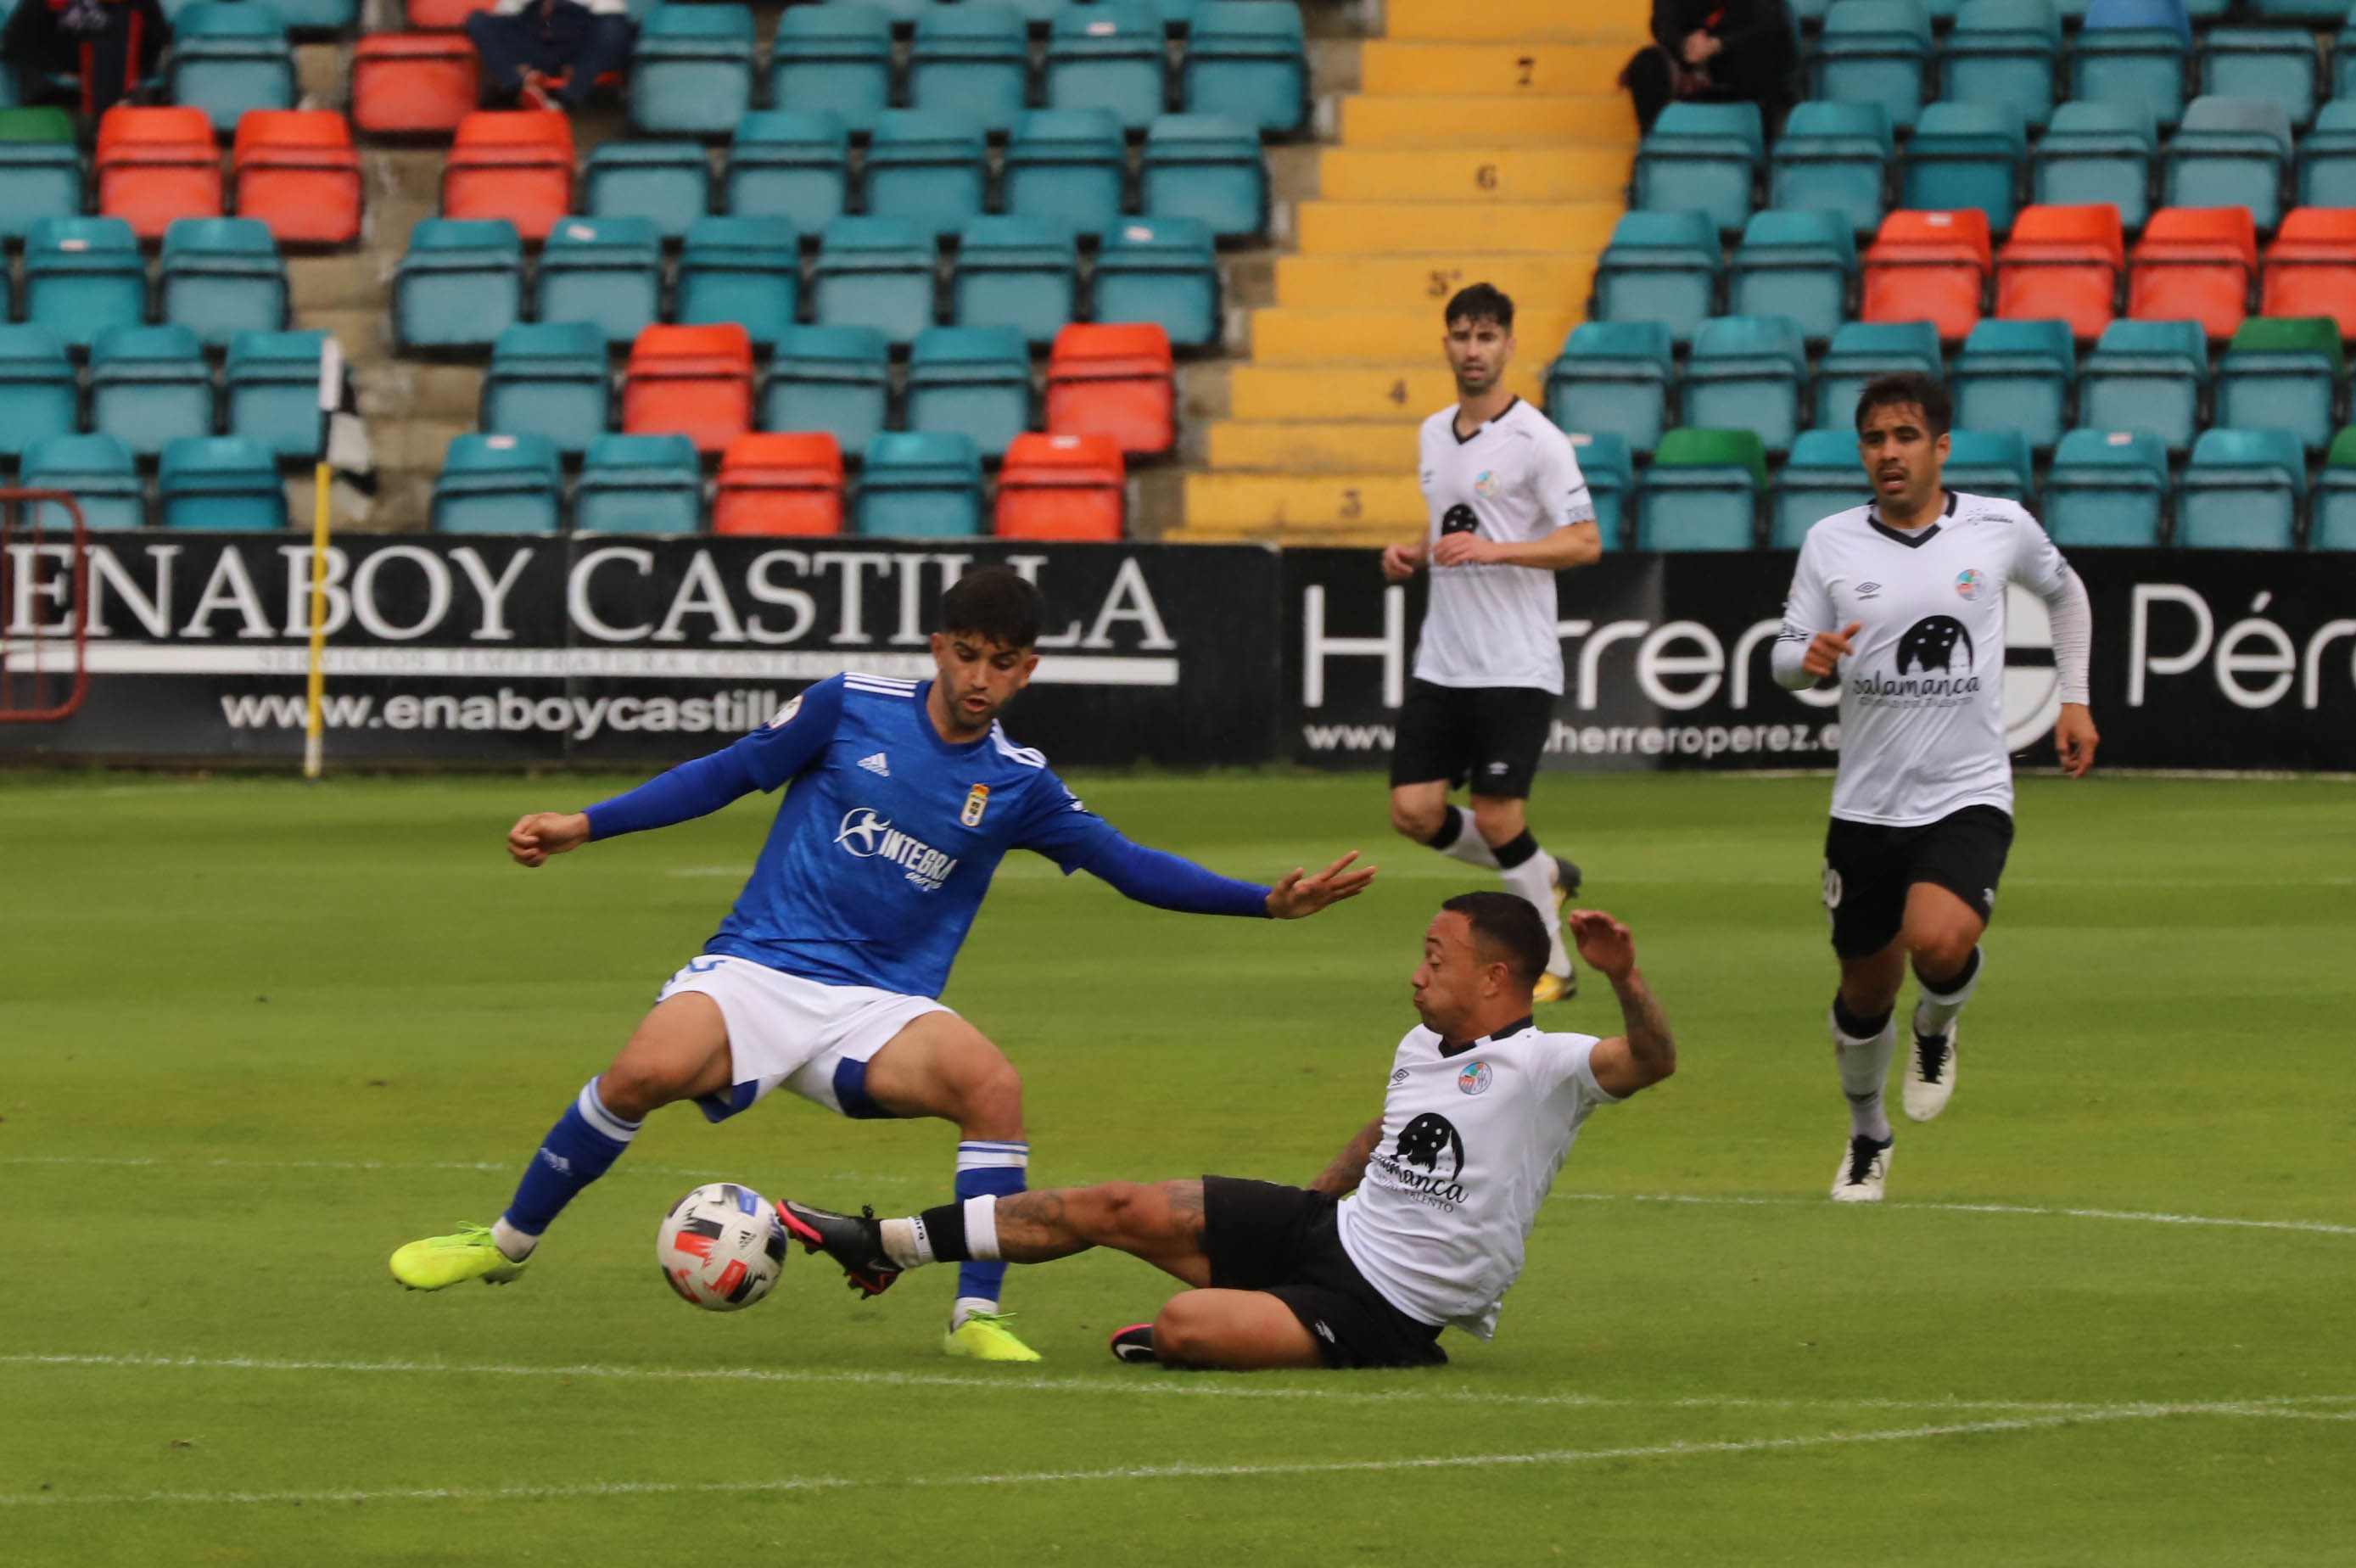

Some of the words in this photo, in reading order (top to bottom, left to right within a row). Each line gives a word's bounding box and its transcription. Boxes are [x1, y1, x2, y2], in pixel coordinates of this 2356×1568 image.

[1475, 164, 1497, 190] 6
[1387, 378, 1408, 406] 4
[4, 544, 534, 640] ENABOY
[567, 546, 1178, 650] CASTILA
[2127, 583, 2356, 710] Pér
[220, 686, 786, 740] www.enaboycastill
[878, 828, 958, 882] INTEGRA
